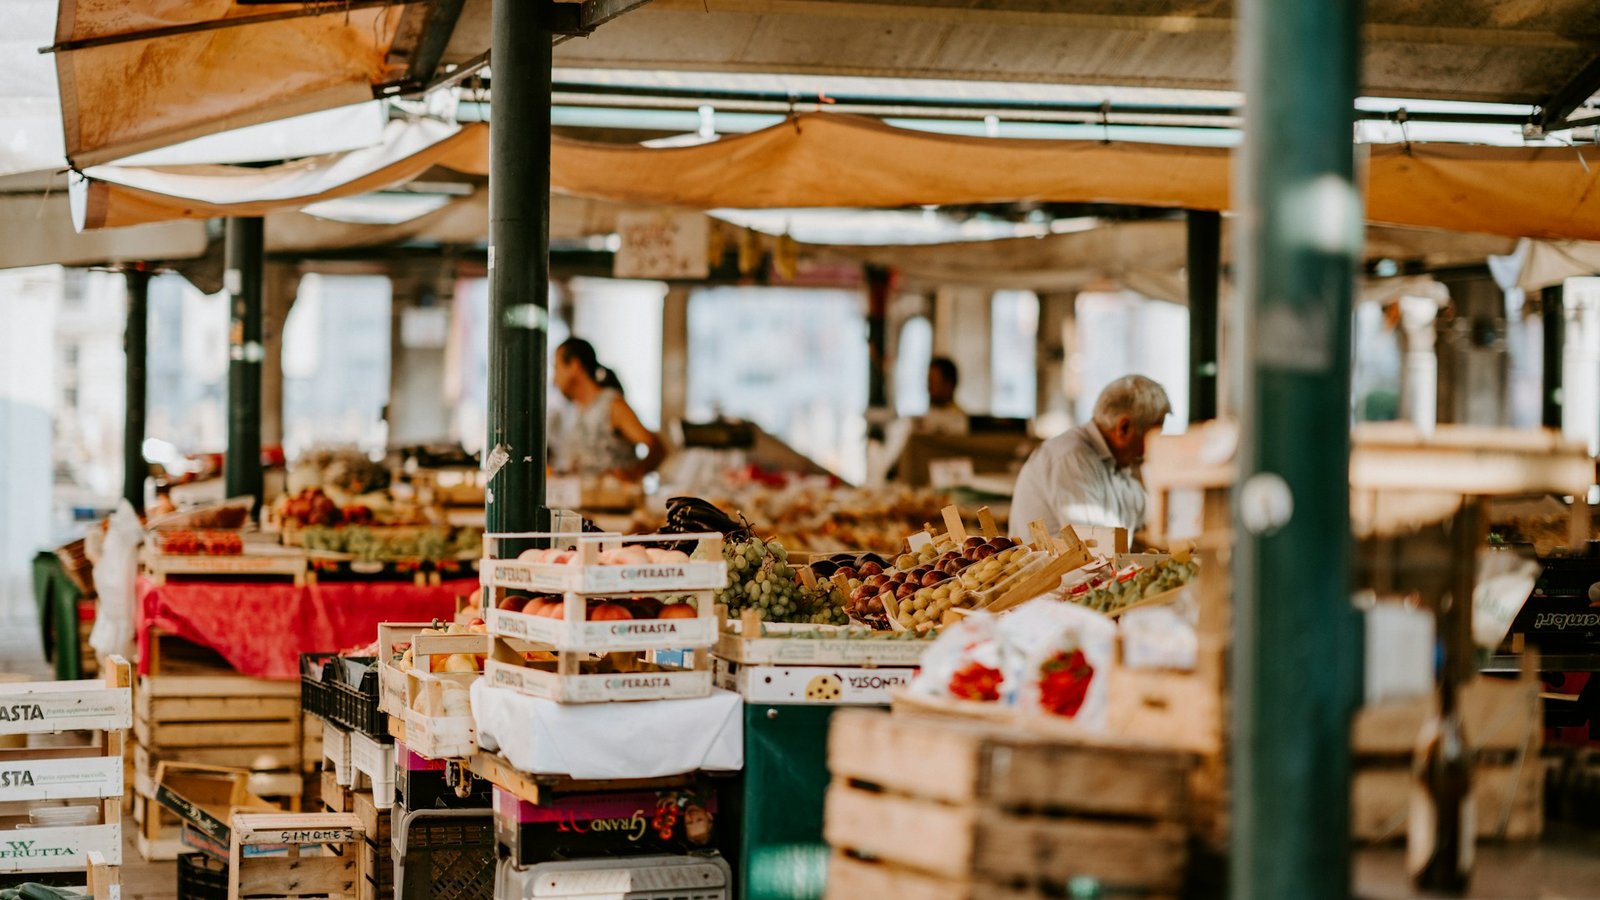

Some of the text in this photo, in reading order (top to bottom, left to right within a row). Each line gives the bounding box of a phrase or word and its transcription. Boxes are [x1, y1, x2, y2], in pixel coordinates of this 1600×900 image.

[621, 567, 685, 579] COFERASTA
[1534, 613, 1600, 630] embri
[611, 624, 677, 635] COFERASTA
[605, 677, 671, 689] COFERASTA
[0, 770, 34, 788] STA
[591, 809, 647, 841] GRAND
[0, 848, 75, 858] FRUTTA
